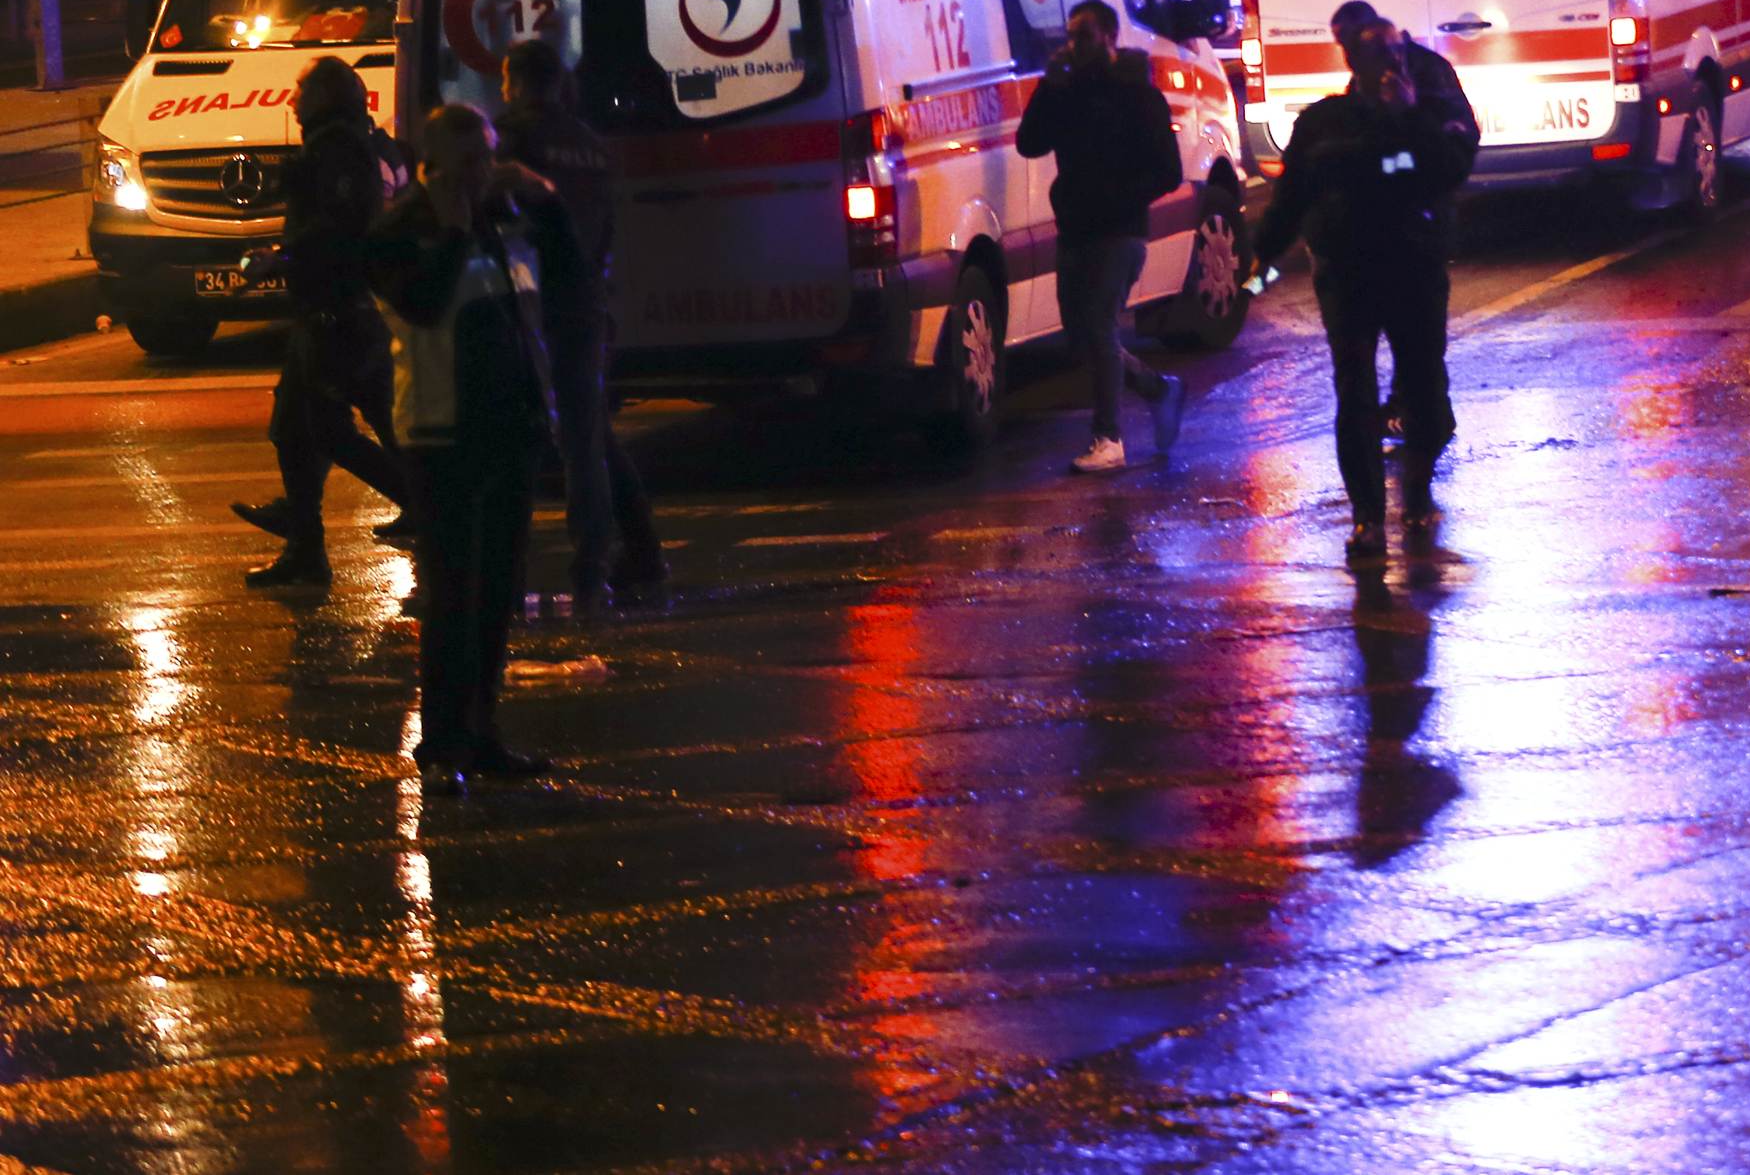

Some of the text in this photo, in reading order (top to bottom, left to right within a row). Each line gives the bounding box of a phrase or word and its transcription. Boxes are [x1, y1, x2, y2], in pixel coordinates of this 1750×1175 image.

[925, 0, 971, 72] 112
[906, 85, 1001, 139] AMBULANS
[205, 271, 225, 291] 34
